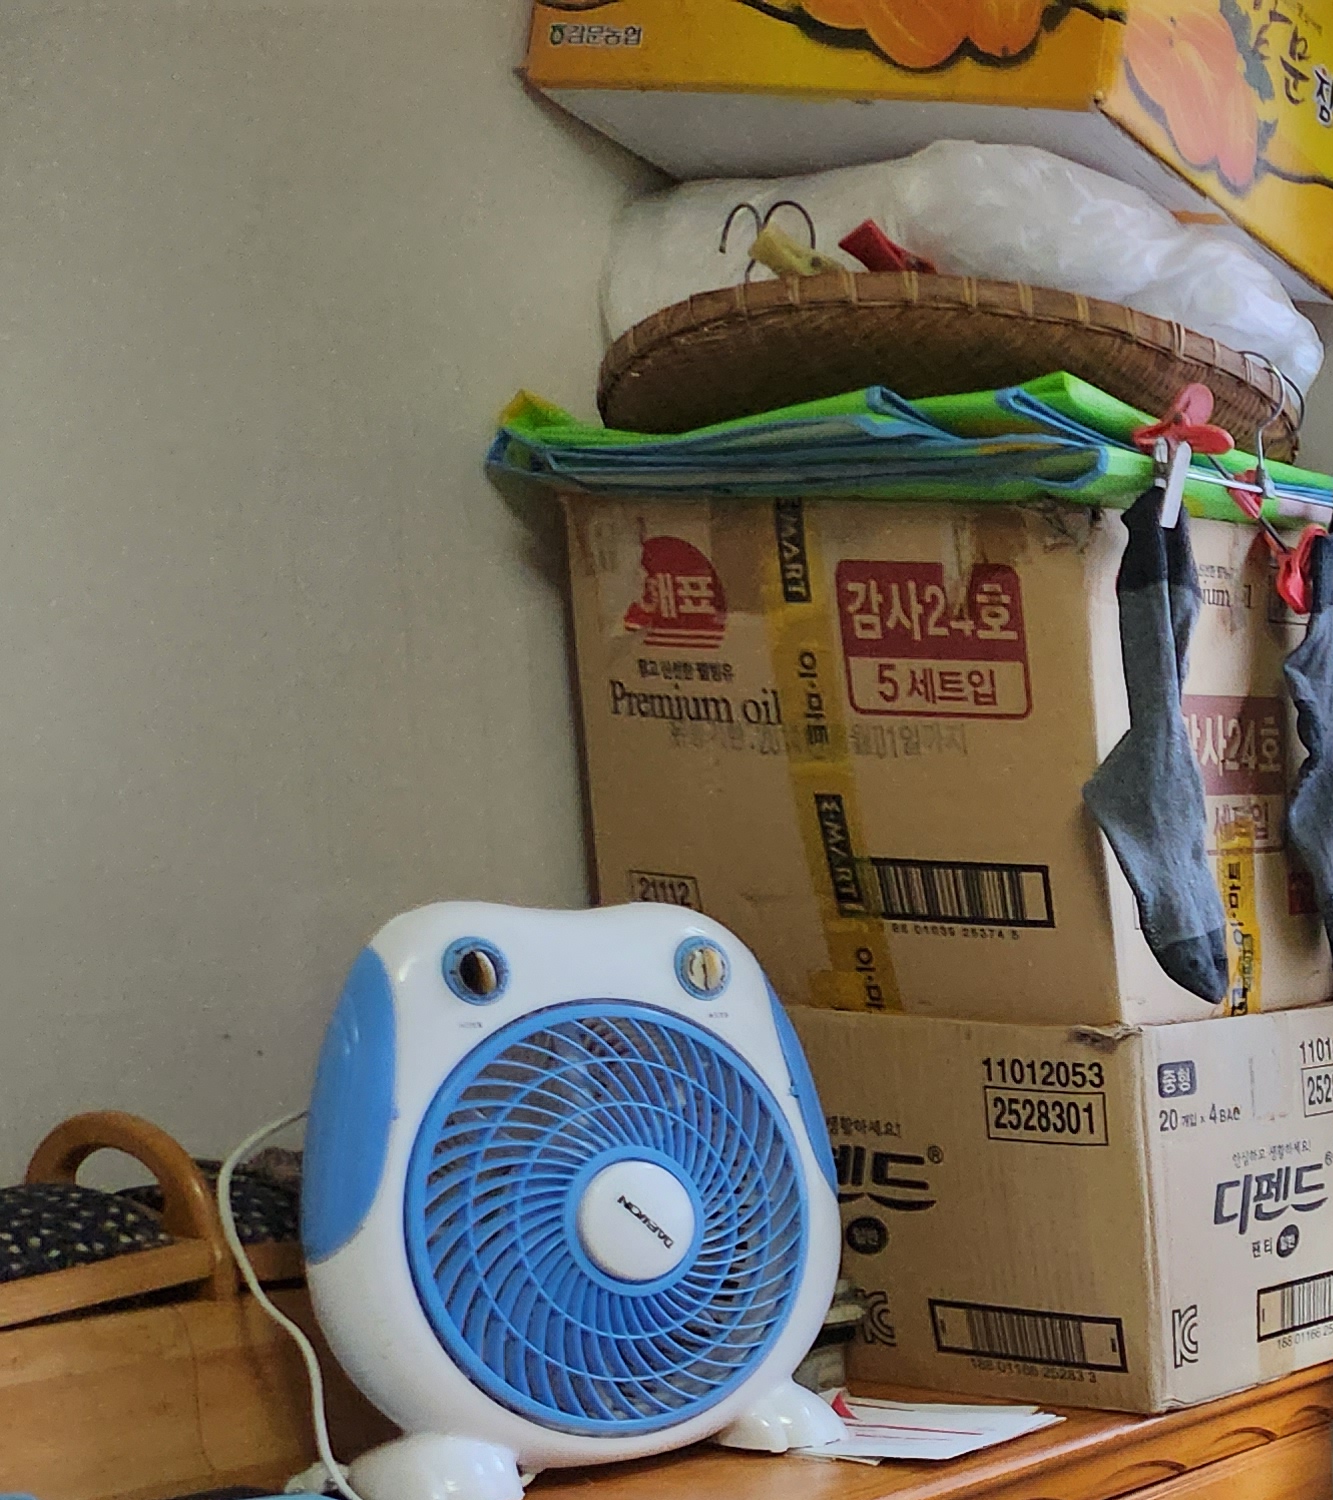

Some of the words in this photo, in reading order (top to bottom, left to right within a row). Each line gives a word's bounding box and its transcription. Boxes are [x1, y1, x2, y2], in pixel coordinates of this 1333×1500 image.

[847, 579, 1018, 641] 감사24호
[609, 680, 734, 724] Premium
[743, 689, 782, 726] oil
[878, 664, 899, 702] 5
[907, 668, 998, 706] 세트입
[982, 1057, 1105, 1088] 11012053
[992, 1096, 1097, 1135] 2528301
[1214, 1163, 1328, 1235] 디펜드
